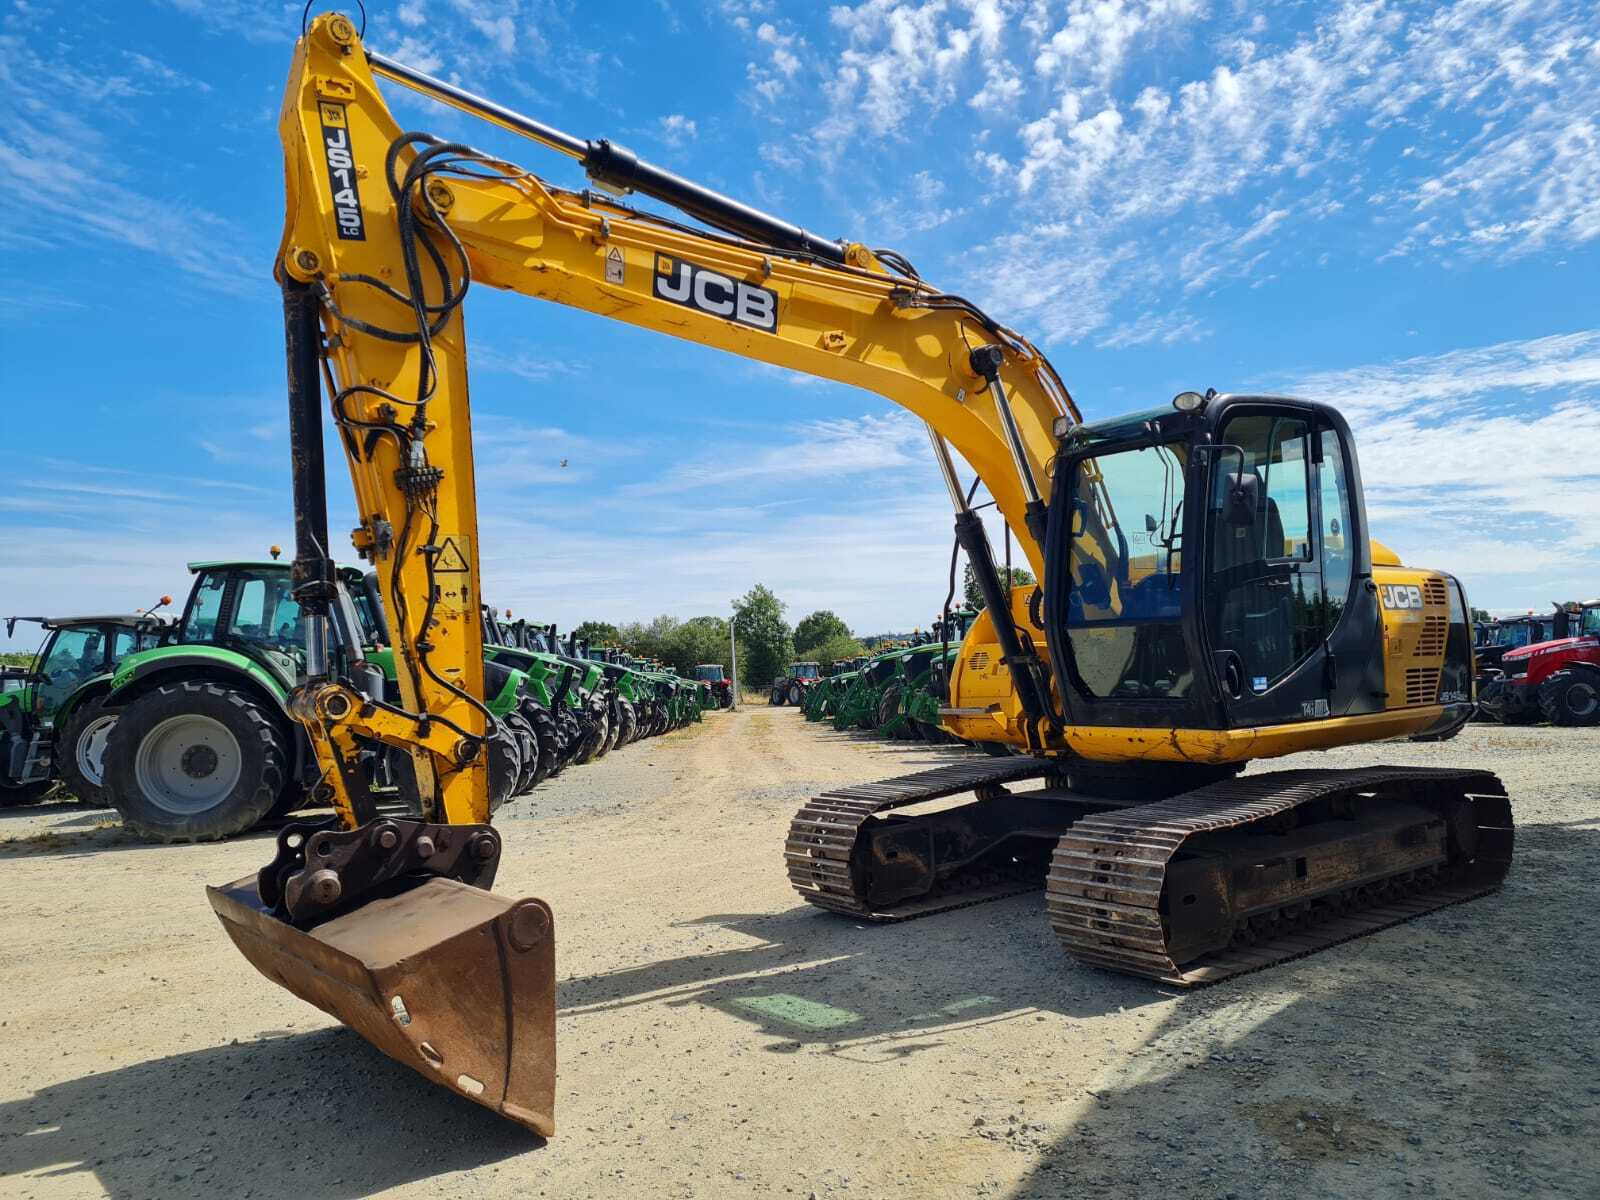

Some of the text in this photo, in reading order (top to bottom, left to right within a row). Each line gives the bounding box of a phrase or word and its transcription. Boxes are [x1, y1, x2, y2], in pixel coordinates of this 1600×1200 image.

[327, 129, 361, 227] JS145
[343, 227, 359, 236] LC
[657, 263, 775, 328] JCB
[1384, 585, 1423, 609] JCB
